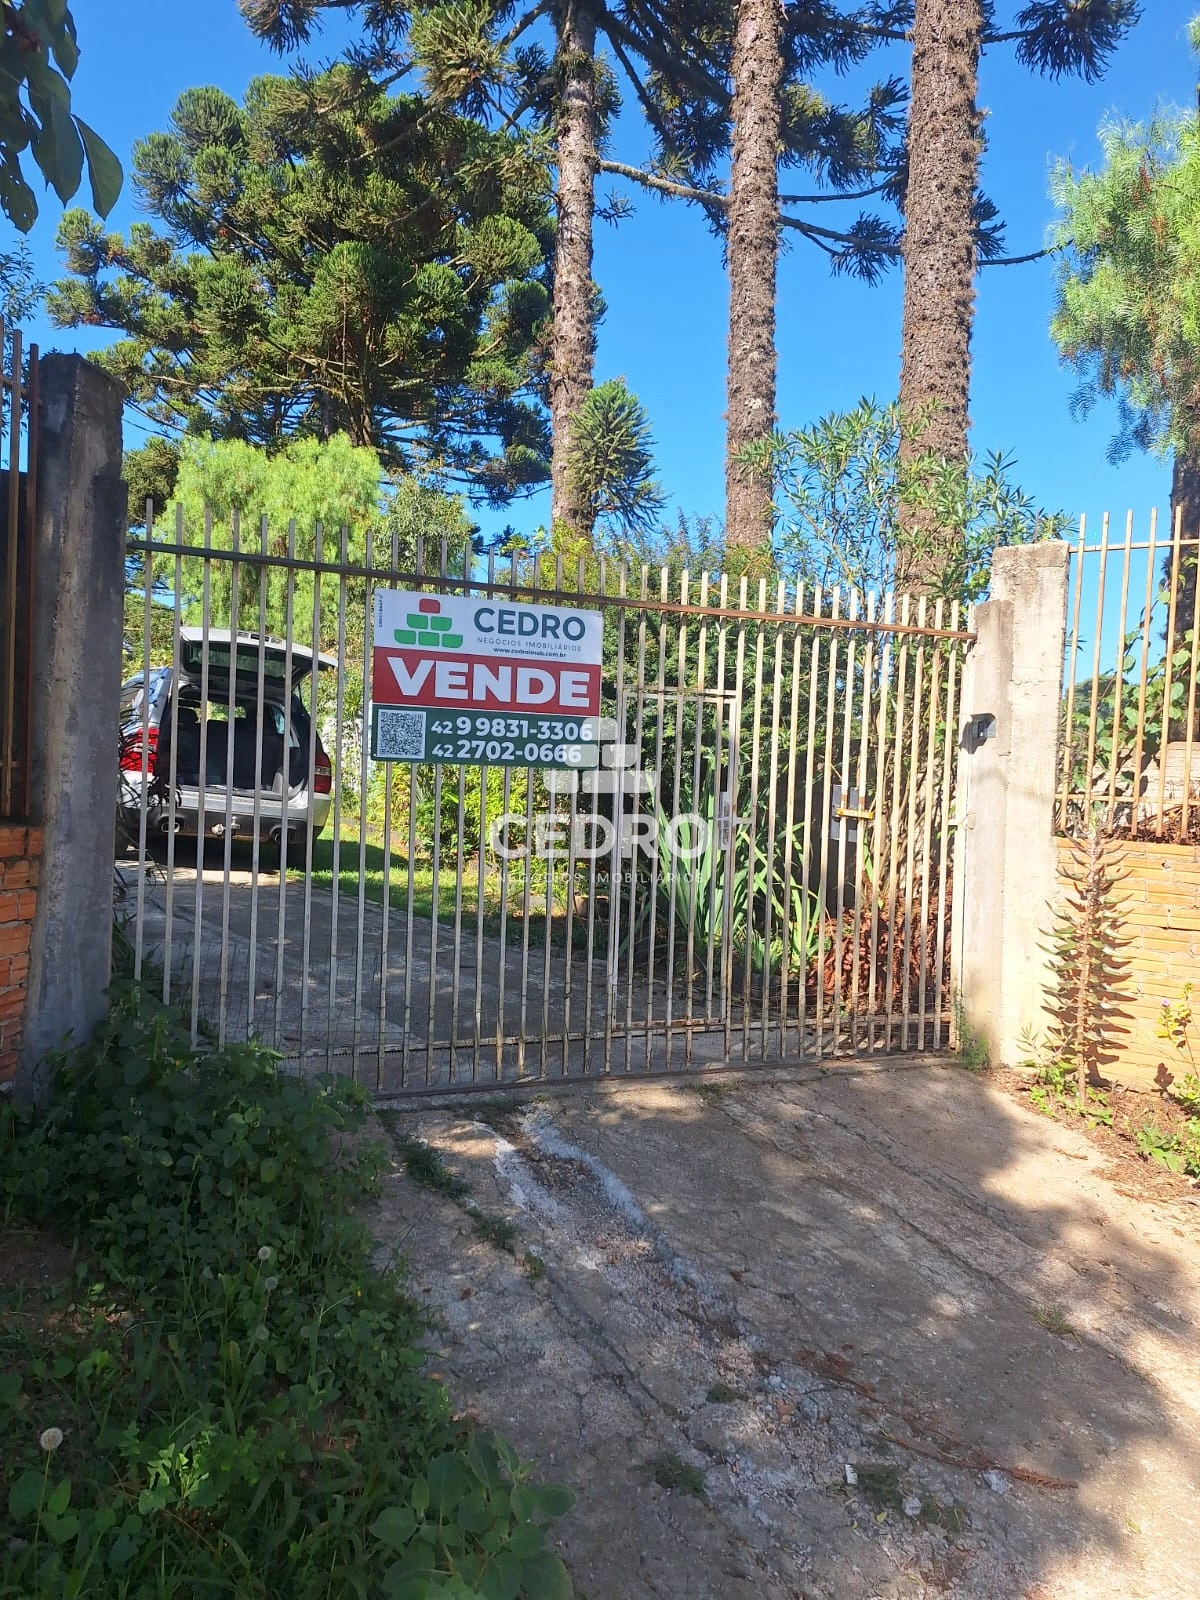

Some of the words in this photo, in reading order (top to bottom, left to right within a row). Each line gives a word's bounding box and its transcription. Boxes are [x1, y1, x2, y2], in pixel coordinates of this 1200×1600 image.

[474, 607, 586, 641] CEDRO
[477, 637, 521, 647] NEGÓCIOS
[526, 640, 582, 652] IMOBILIÁRIOS
[387, 656, 590, 708] VENDE
[431, 720, 453, 735] 42
[456, 716, 472, 736] 9
[475, 718, 593, 741] 9831-3306
[432, 743, 454, 758] 42
[456, 740, 582, 763] 2702-0666
